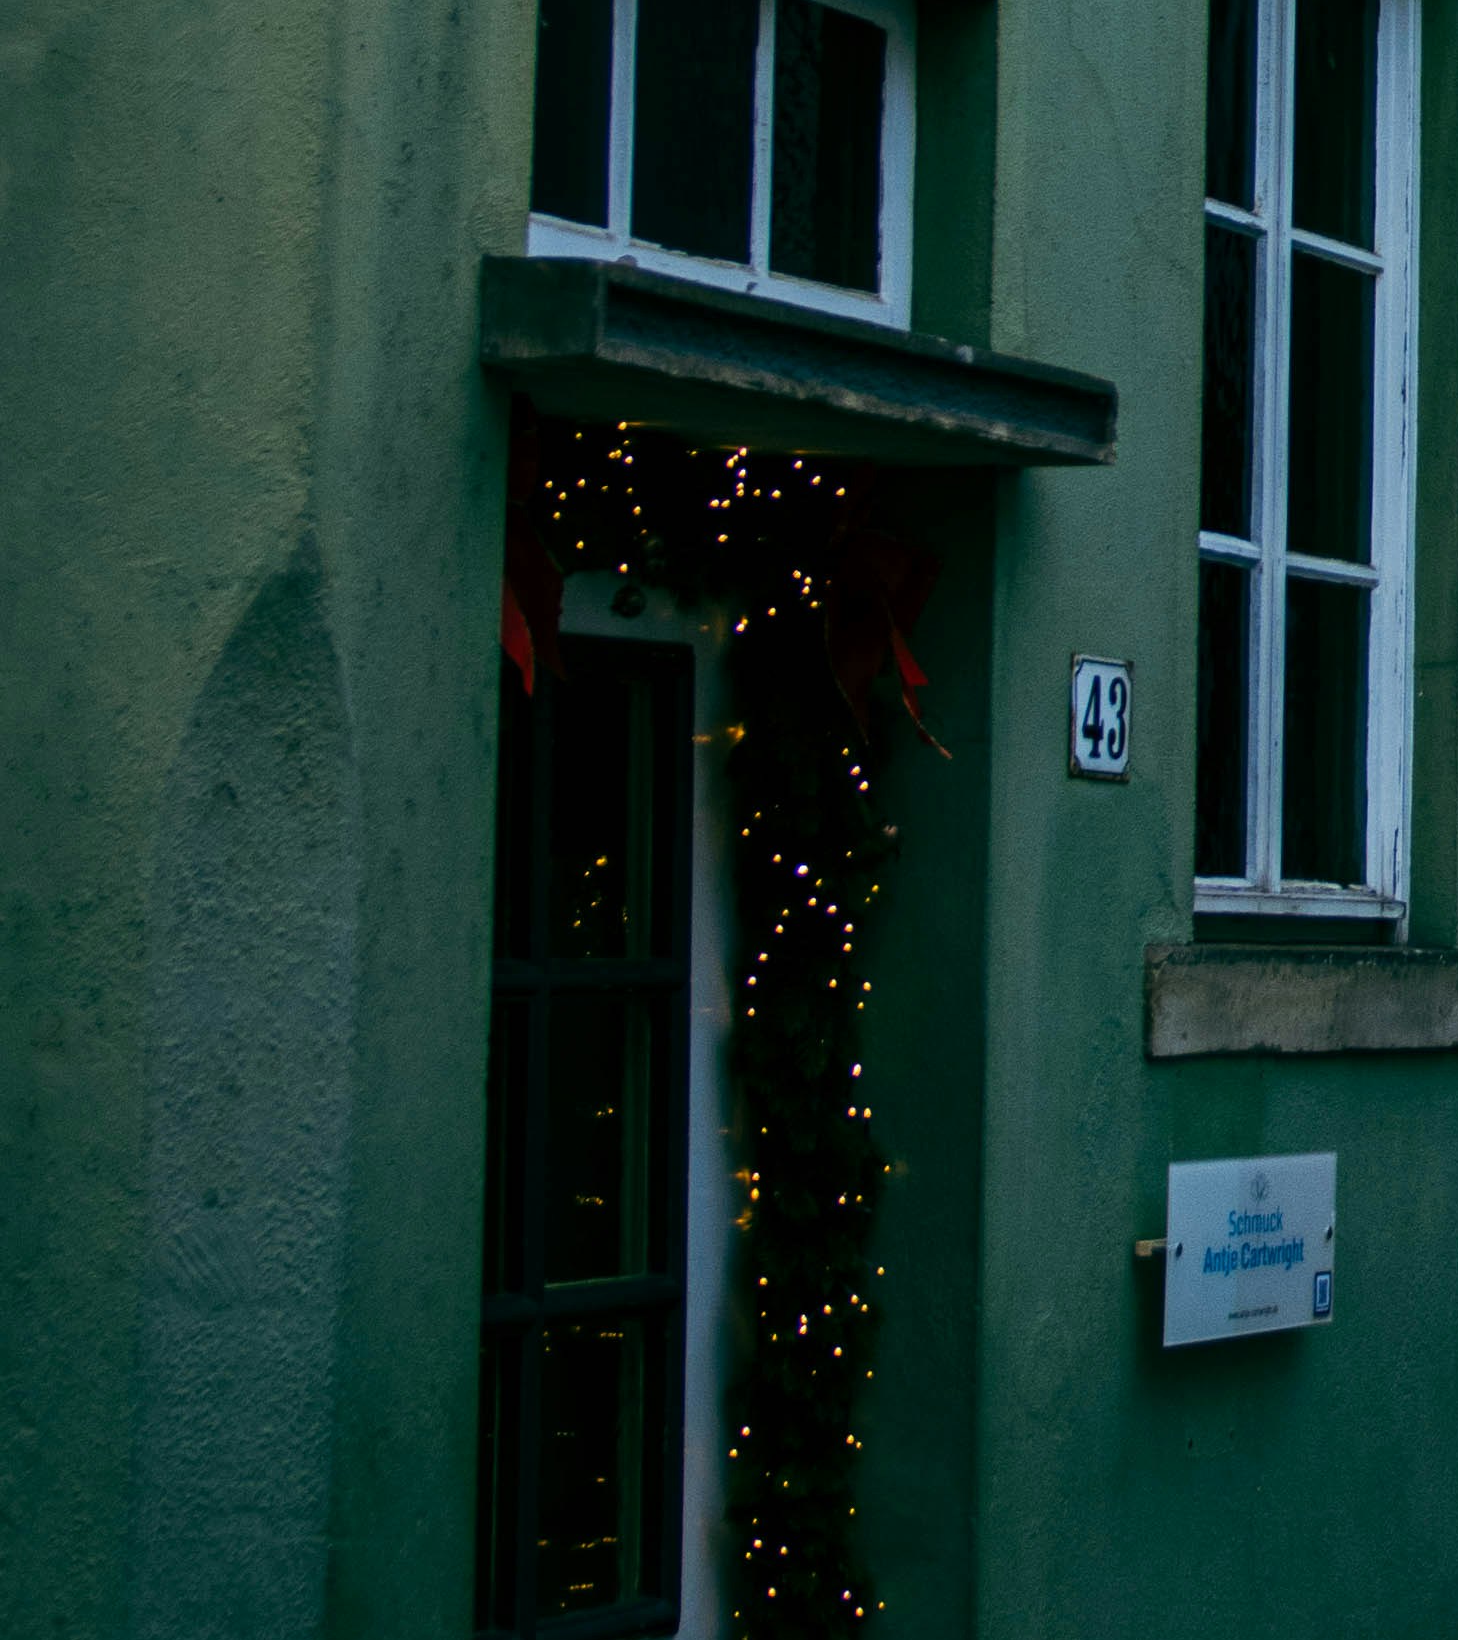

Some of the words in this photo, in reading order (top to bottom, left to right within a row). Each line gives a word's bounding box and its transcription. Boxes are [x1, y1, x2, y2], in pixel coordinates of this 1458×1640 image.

[1081, 673, 1128, 763] 43
[1228, 1206, 1284, 1237] Schmuck
[1203, 1245, 1239, 1277] Antje
[1240, 1237, 1305, 1271] Cartwright
